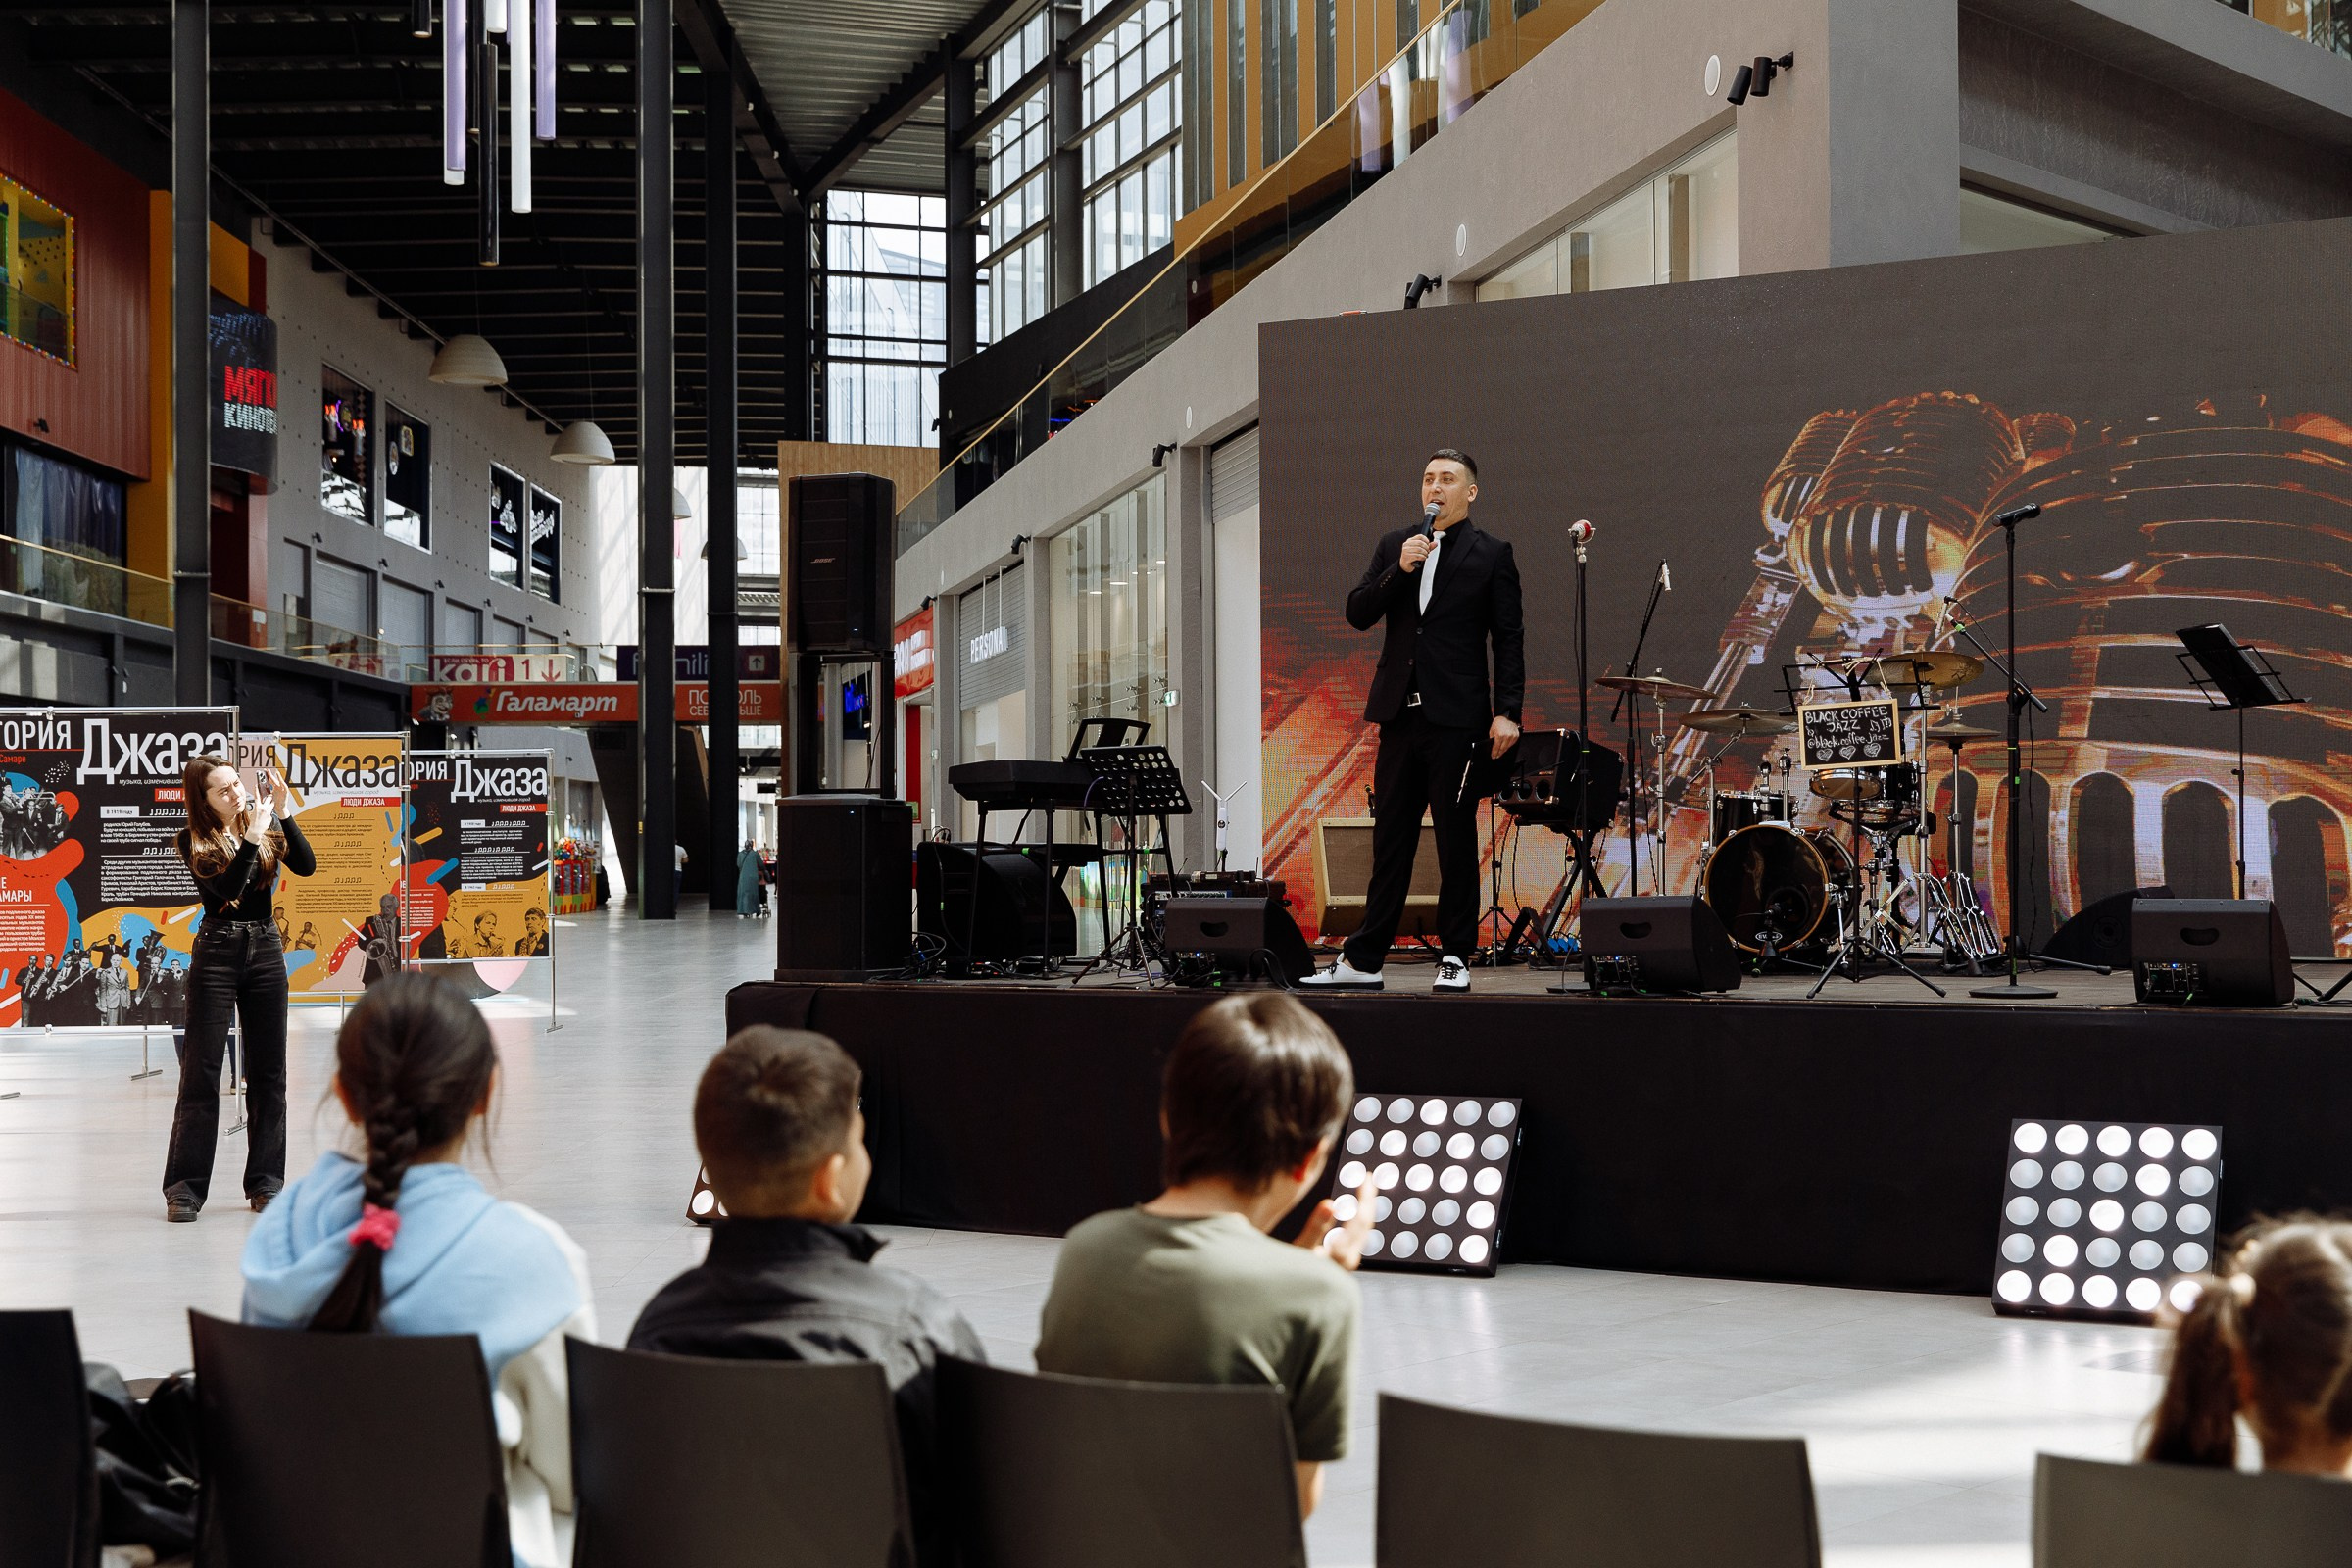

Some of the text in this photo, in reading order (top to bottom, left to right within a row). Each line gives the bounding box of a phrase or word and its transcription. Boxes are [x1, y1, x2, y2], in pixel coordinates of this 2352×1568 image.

[971, 626, 1007, 663] PERSONA
[434, 656, 507, 682] kari
[496, 691, 618, 718] Галамарт
[1805, 706, 1888, 724] BLACK COFFEE
[1826, 720, 1861, 733] JAZZ
[0, 718, 229, 785] ОРИЯ Джаза
[286, 743, 400, 796] Джаза
[450, 760, 547, 803] Джаза
[157, 790, 181, 801] ЛЮДИ
[343, 798, 385, 807] ЛЮДИ ДЖАЗА
